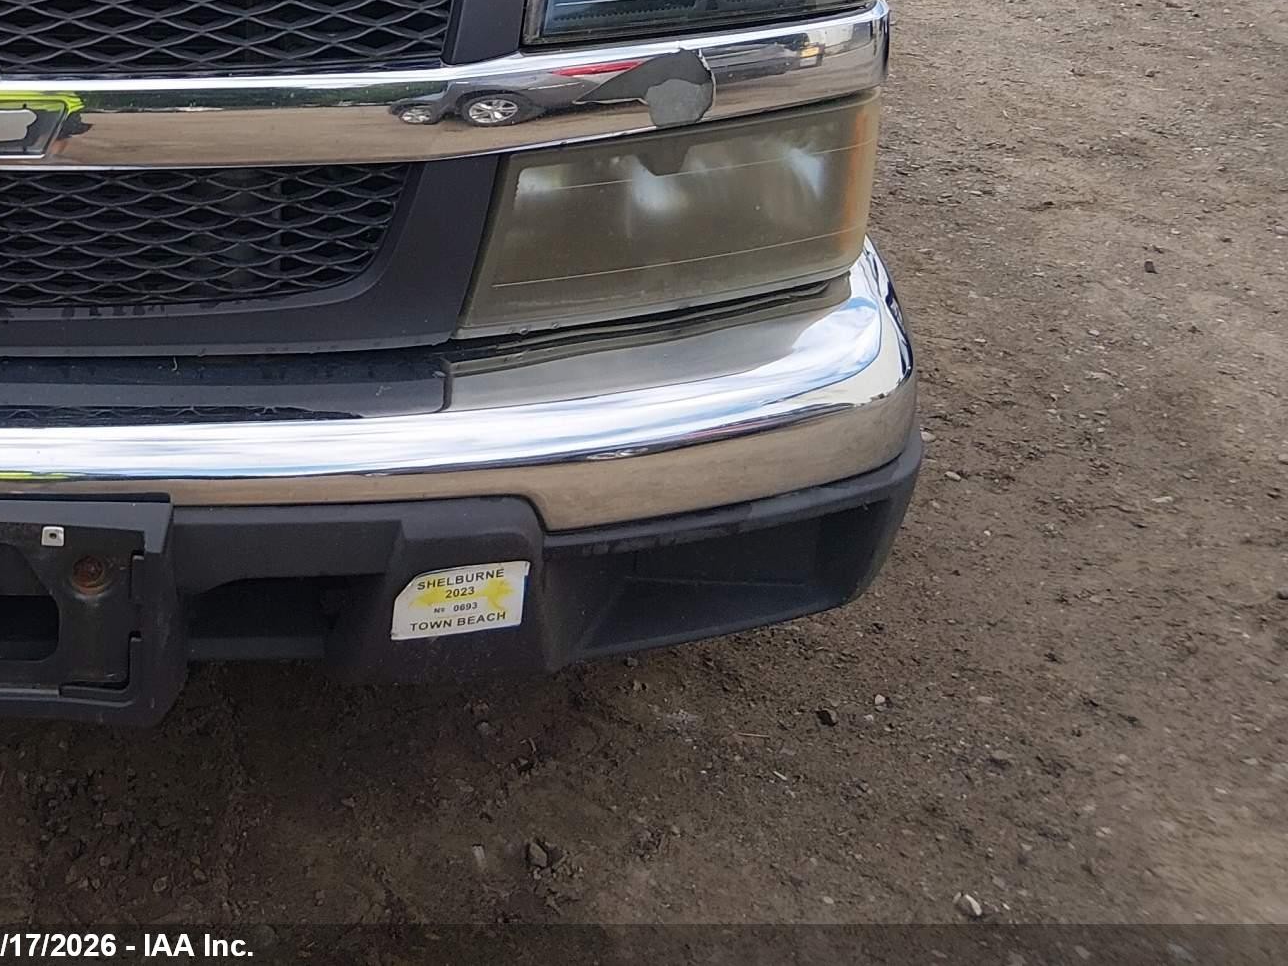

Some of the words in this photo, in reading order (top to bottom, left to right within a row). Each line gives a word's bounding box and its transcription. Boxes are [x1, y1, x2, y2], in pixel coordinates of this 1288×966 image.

[416, 569, 505, 590] SHELBURNE
[445, 587, 475, 599] 2023
[453, 602, 478, 612] 0693
[410, 619, 452, 632] TOWN
[457, 611, 507, 627] BEACH
